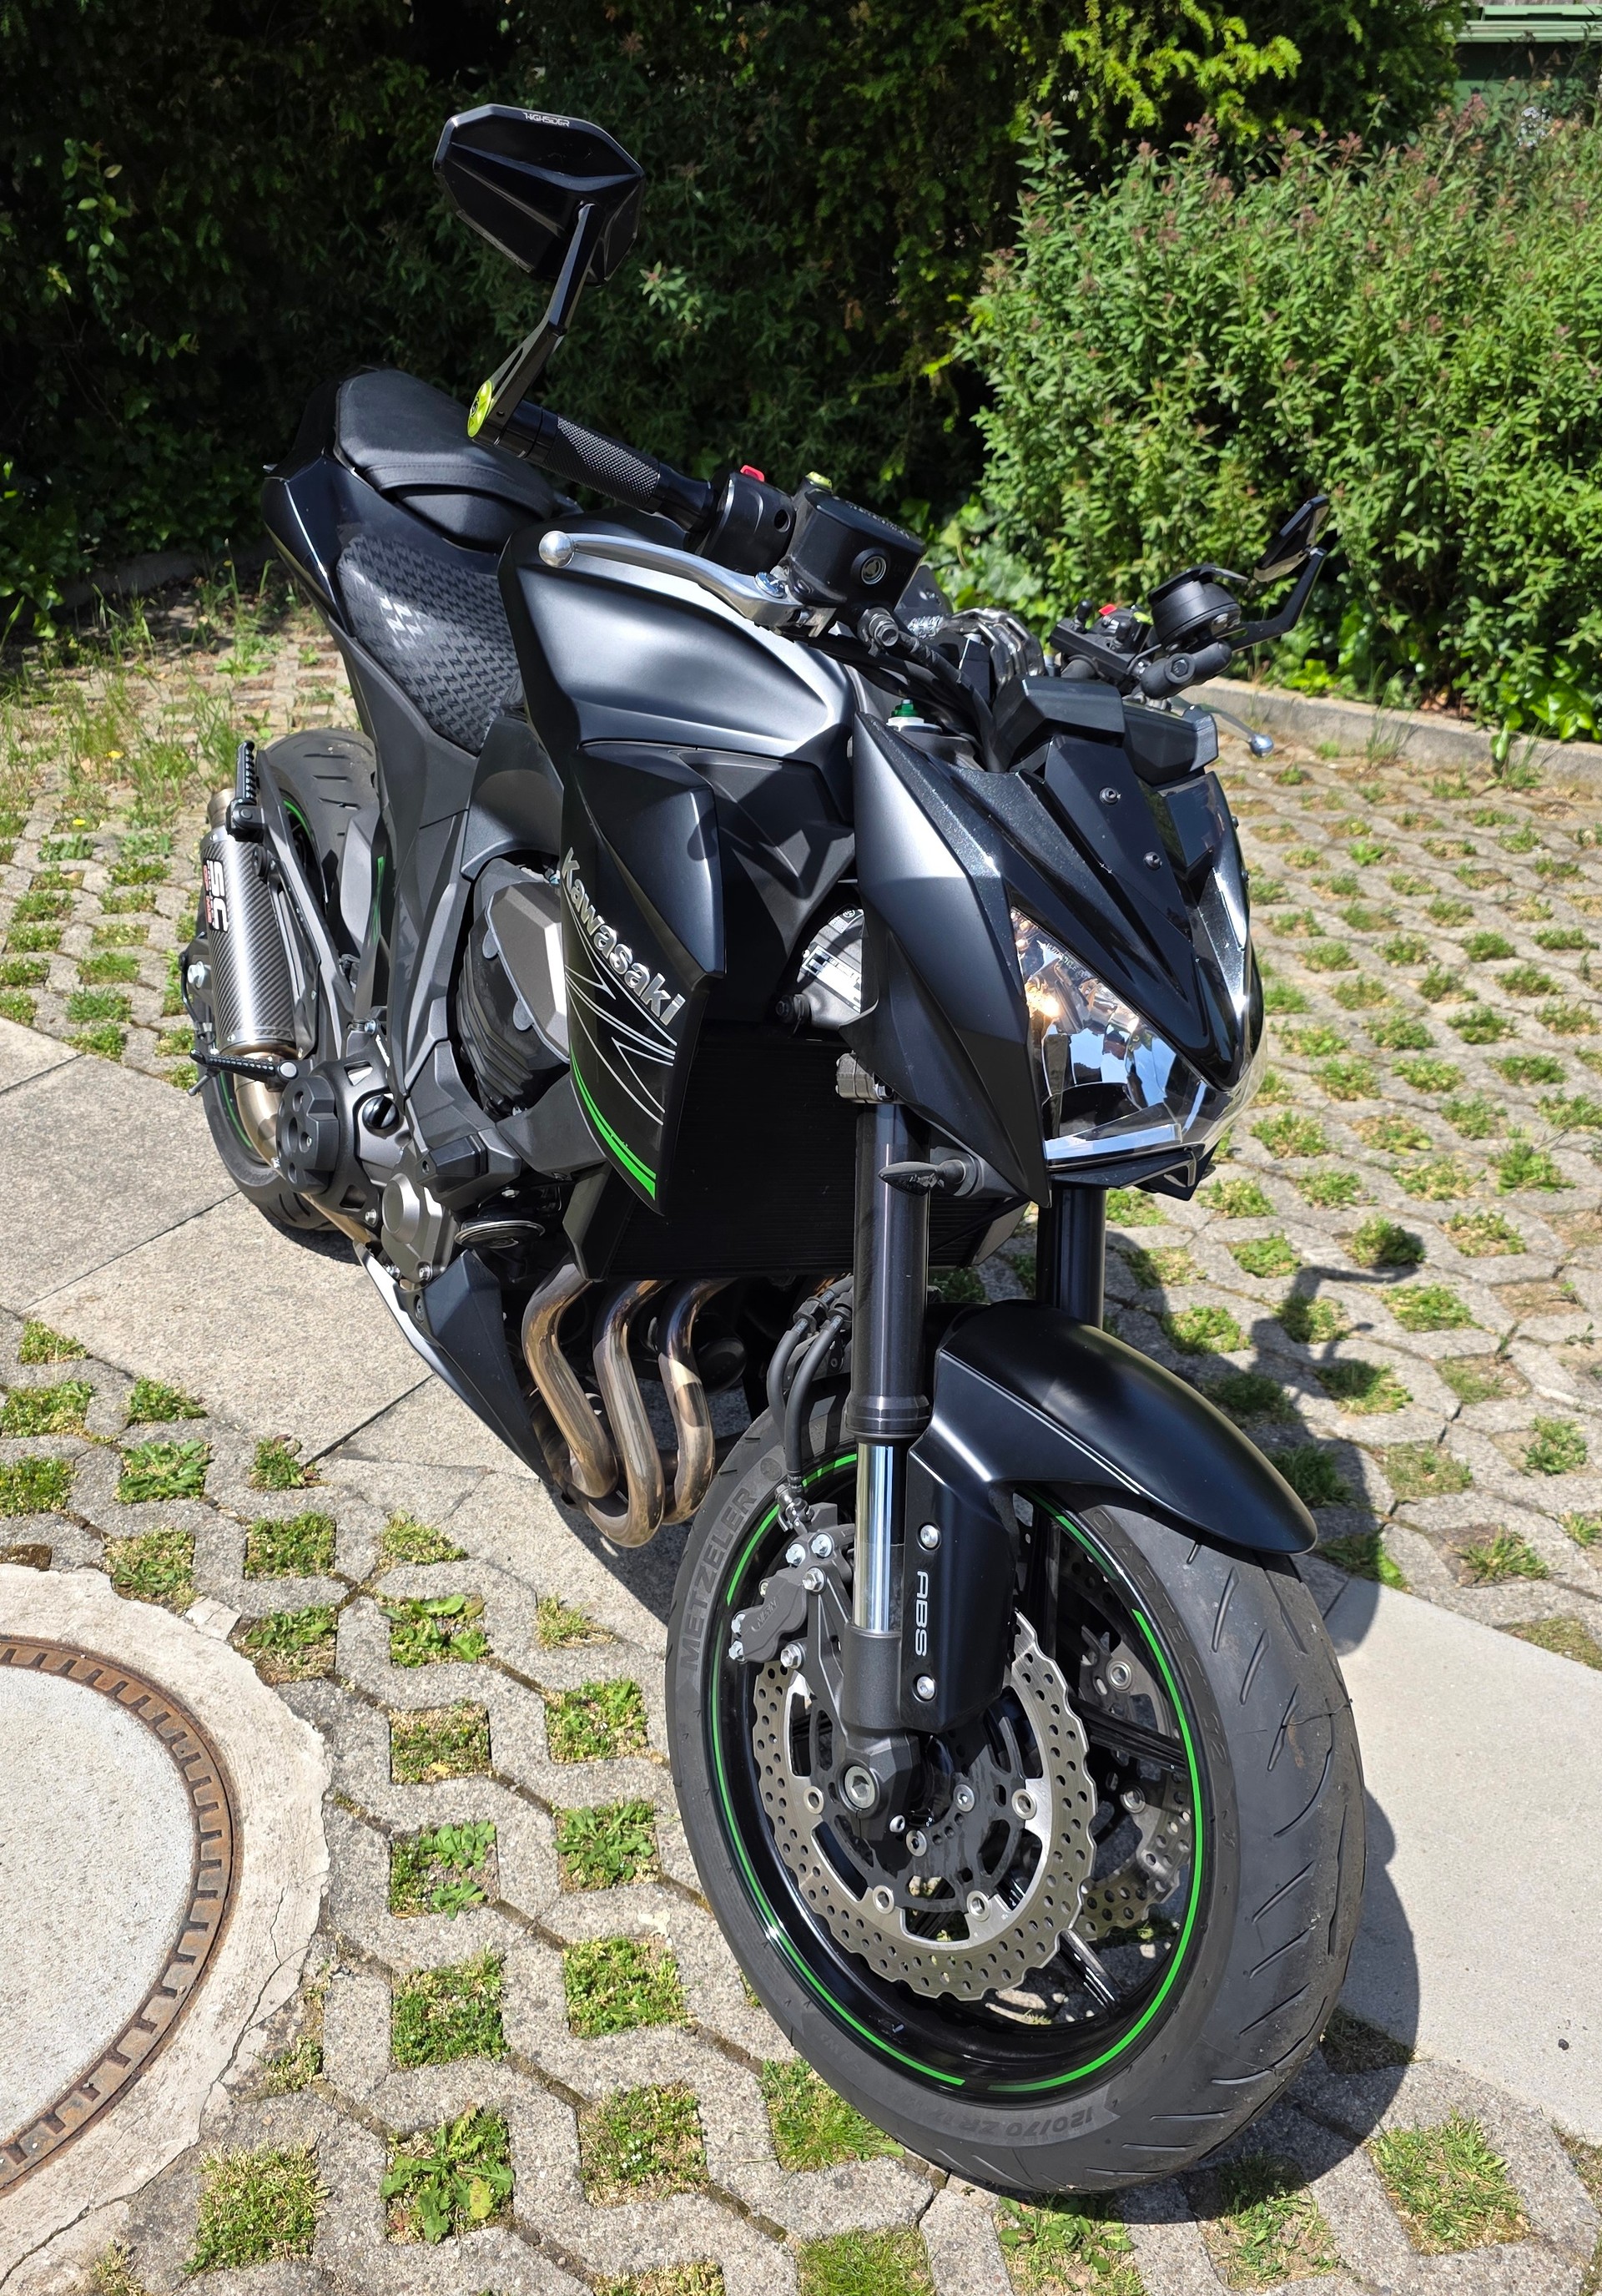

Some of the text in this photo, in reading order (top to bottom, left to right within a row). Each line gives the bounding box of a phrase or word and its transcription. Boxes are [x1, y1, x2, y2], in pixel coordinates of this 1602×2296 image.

[522, 112, 570, 128] HIGHSIDER
[561, 846, 687, 1027] Kawasaki
[679, 1486, 758, 1670] METZELER
[914, 1570, 929, 1657] ABS
[1091, 1506, 1205, 1679] OADTEC
[1005, 2105, 1093, 2137] 120/70
